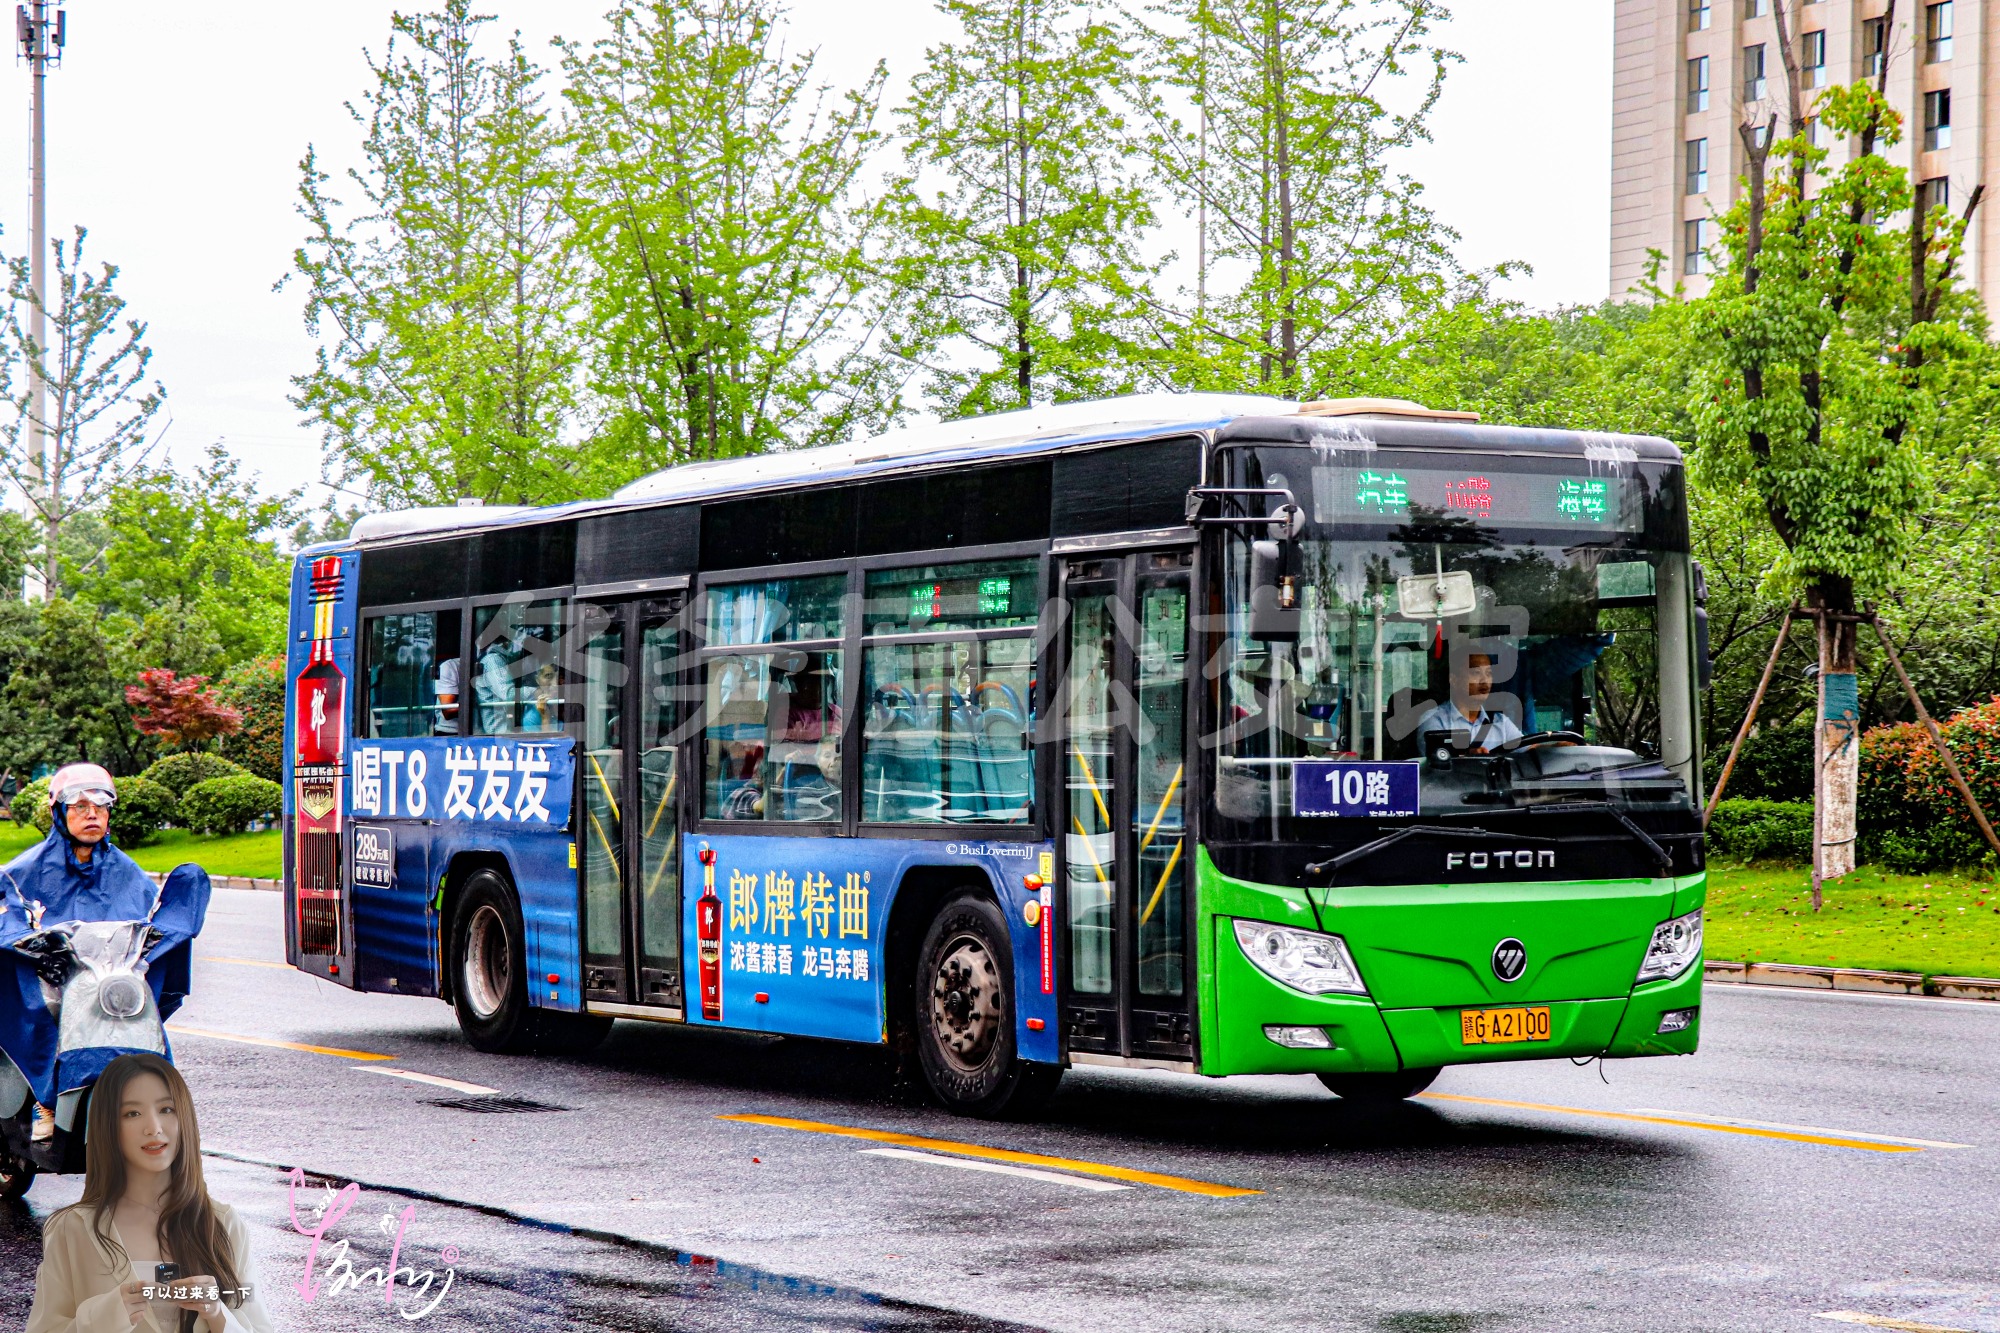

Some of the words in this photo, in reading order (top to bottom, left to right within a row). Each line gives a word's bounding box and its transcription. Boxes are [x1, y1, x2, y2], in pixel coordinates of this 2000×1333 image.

[352, 747, 427, 817] 喝T8
[444, 745, 551, 823] 发发发
[1325, 769, 1390, 805] 10路
[1446, 850, 1555, 870] FOTON
[730, 941, 793, 976] 浓酱兼香
[802, 946, 869, 982] 龙马奔腾
